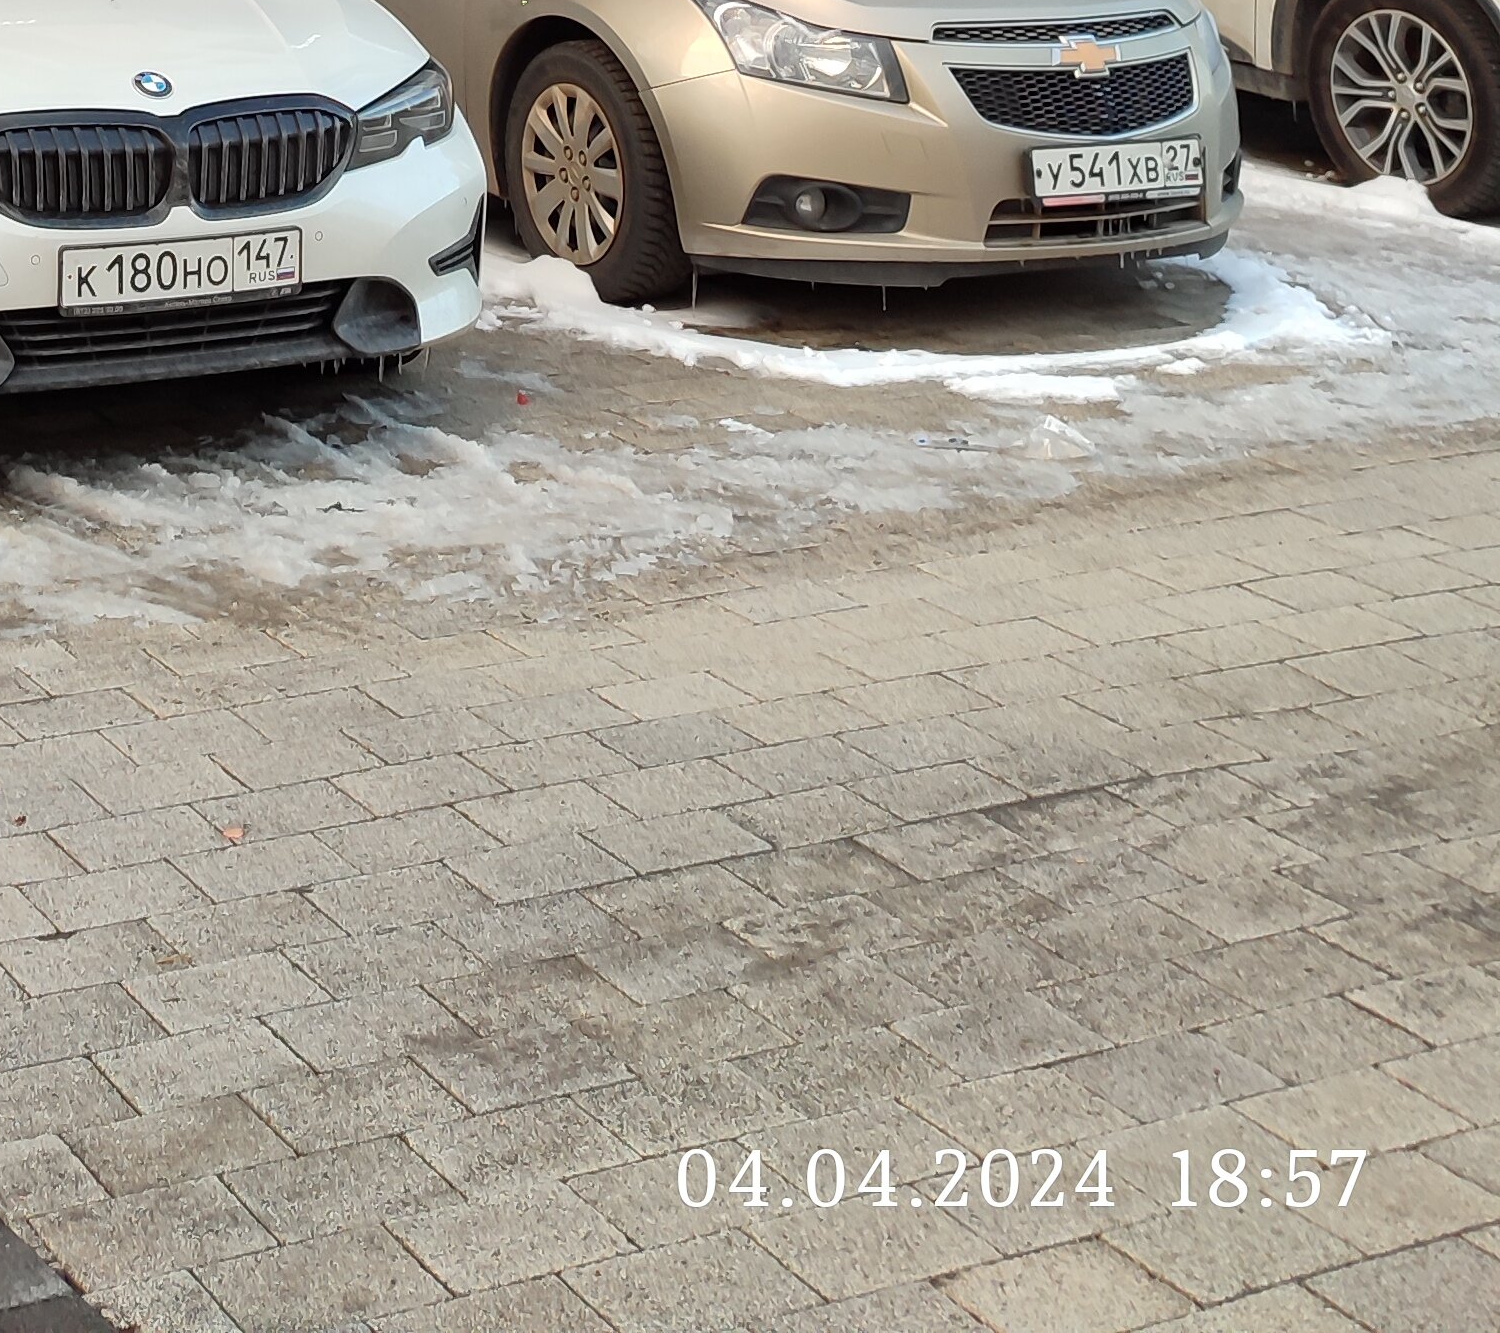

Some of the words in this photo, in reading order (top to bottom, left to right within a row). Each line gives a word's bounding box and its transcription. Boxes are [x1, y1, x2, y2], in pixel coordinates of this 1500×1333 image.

[1165, 144, 1191, 171] 27
[236, 236, 289, 271] 147
[248, 270, 276, 284] RUS
